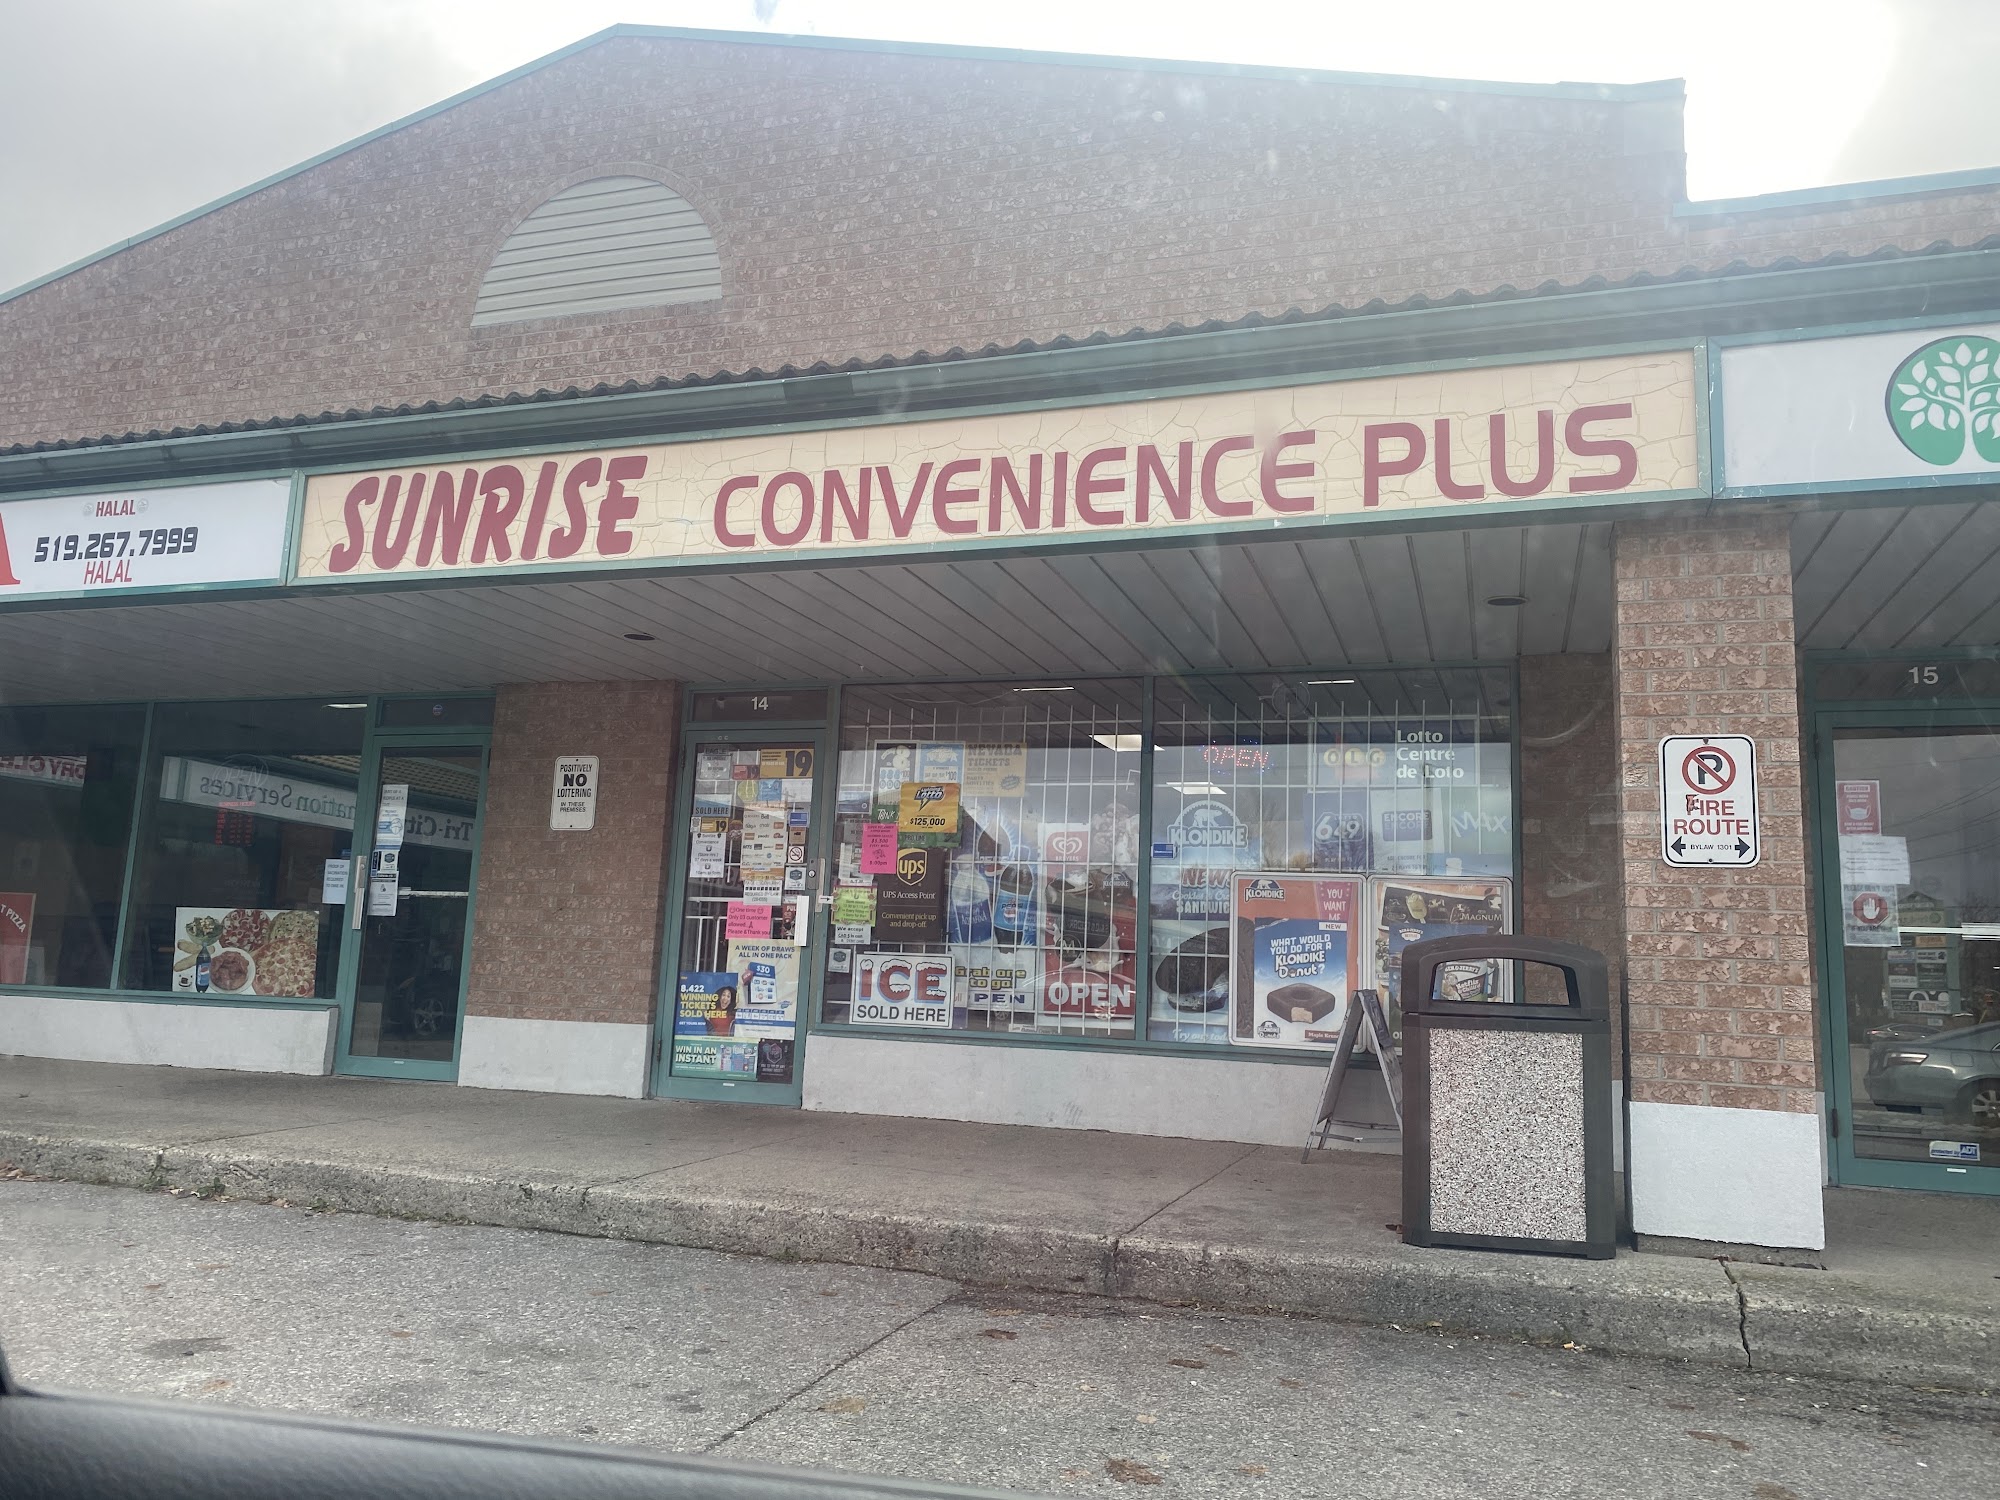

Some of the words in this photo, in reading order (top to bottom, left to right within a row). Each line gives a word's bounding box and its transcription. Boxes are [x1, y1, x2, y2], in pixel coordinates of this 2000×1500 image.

[329, 455, 649, 574] SUNRISE
[713, 429, 1317, 548] CONVENIENCE
[1362, 402, 1638, 508] PLUS
[96, 499, 136, 518] HALAL
[34, 526, 199, 563] 519.267.7999
[83, 559, 133, 585] HALAL
[1908, 665, 1939, 685] 15
[751, 696, 769, 711] 14
[1397, 729, 1444, 743] Lotto
[1204, 746, 1269, 768] OPEN
[1397, 747, 1456, 761] Centre
[559, 763, 593, 773] POSITIVELY
[786, 750, 813, 777] 19
[968, 757, 1011, 767] TICKETS
[1396, 764, 1418, 779] de
[1425, 764, 1465, 779] Loto
[563, 773, 588, 787] NO
[557, 788, 592, 798] LOITERING
[695, 807, 712, 815] SOLD
[1685, 794, 1735, 816] FIRE
[909, 817, 946, 827] $125,000
[1384, 812, 1430, 822] ENCORE
[715, 820, 727, 832] 19
[1673, 818, 1750, 836] ROUTE
[1170, 827, 1246, 847] KLONDIKE
[899, 859, 925, 880] ups
[882, 890, 897, 899] UPS
[897, 891, 919, 900] Access
[919, 892, 936, 900] Point
[1245, 888, 1285, 902] KLONDIKE
[1327, 888, 1343, 899] YOU
[1176, 900, 1230, 914] SANDWIC
[1323, 901, 1346, 911] WANT
[5, 908, 27, 934] PIZZA
[881, 911, 915, 920] Convenient
[915, 912, 928, 921] pick
[928, 914, 937, 922] up
[1460, 913, 1503, 921] MAGNUM
[889, 920, 901, 928] and
[1270, 936, 1297, 948] WHAT
[1299, 934, 1331, 944] WOULD
[1269, 946, 1288, 956] YOU
[1290, 944, 1302, 953] DO
[1305, 943, 1323, 952] FOR
[1325, 941, 1332, 950] A
[1275, 950, 1325, 971] KLONDIKE
[756, 965, 771, 974] $30
[954, 965, 991, 979] Grab
[858, 957, 948, 1005] ICE
[968, 978, 988, 988] to
[680, 984, 705, 993] 8,422
[1048, 981, 1131, 1009] OPEN
[680, 993, 719, 1002] WINNING
[968, 992, 1026, 1005] PEN
[680, 1001, 717, 1010] TICKETS
[680, 1009, 703, 1018] SOLD
[703, 1010, 727, 1019] HERE
[857, 1004, 900, 1021] SOLD
[904, 1006, 947, 1023] HERE
[675, 1044, 692, 1054] WIN
[693, 1045, 703, 1055] IN
[704, 1046, 717, 1055] AN
[675, 1053, 717, 1065] INSTANT
[1961, 1145, 1978, 1155] ADT
